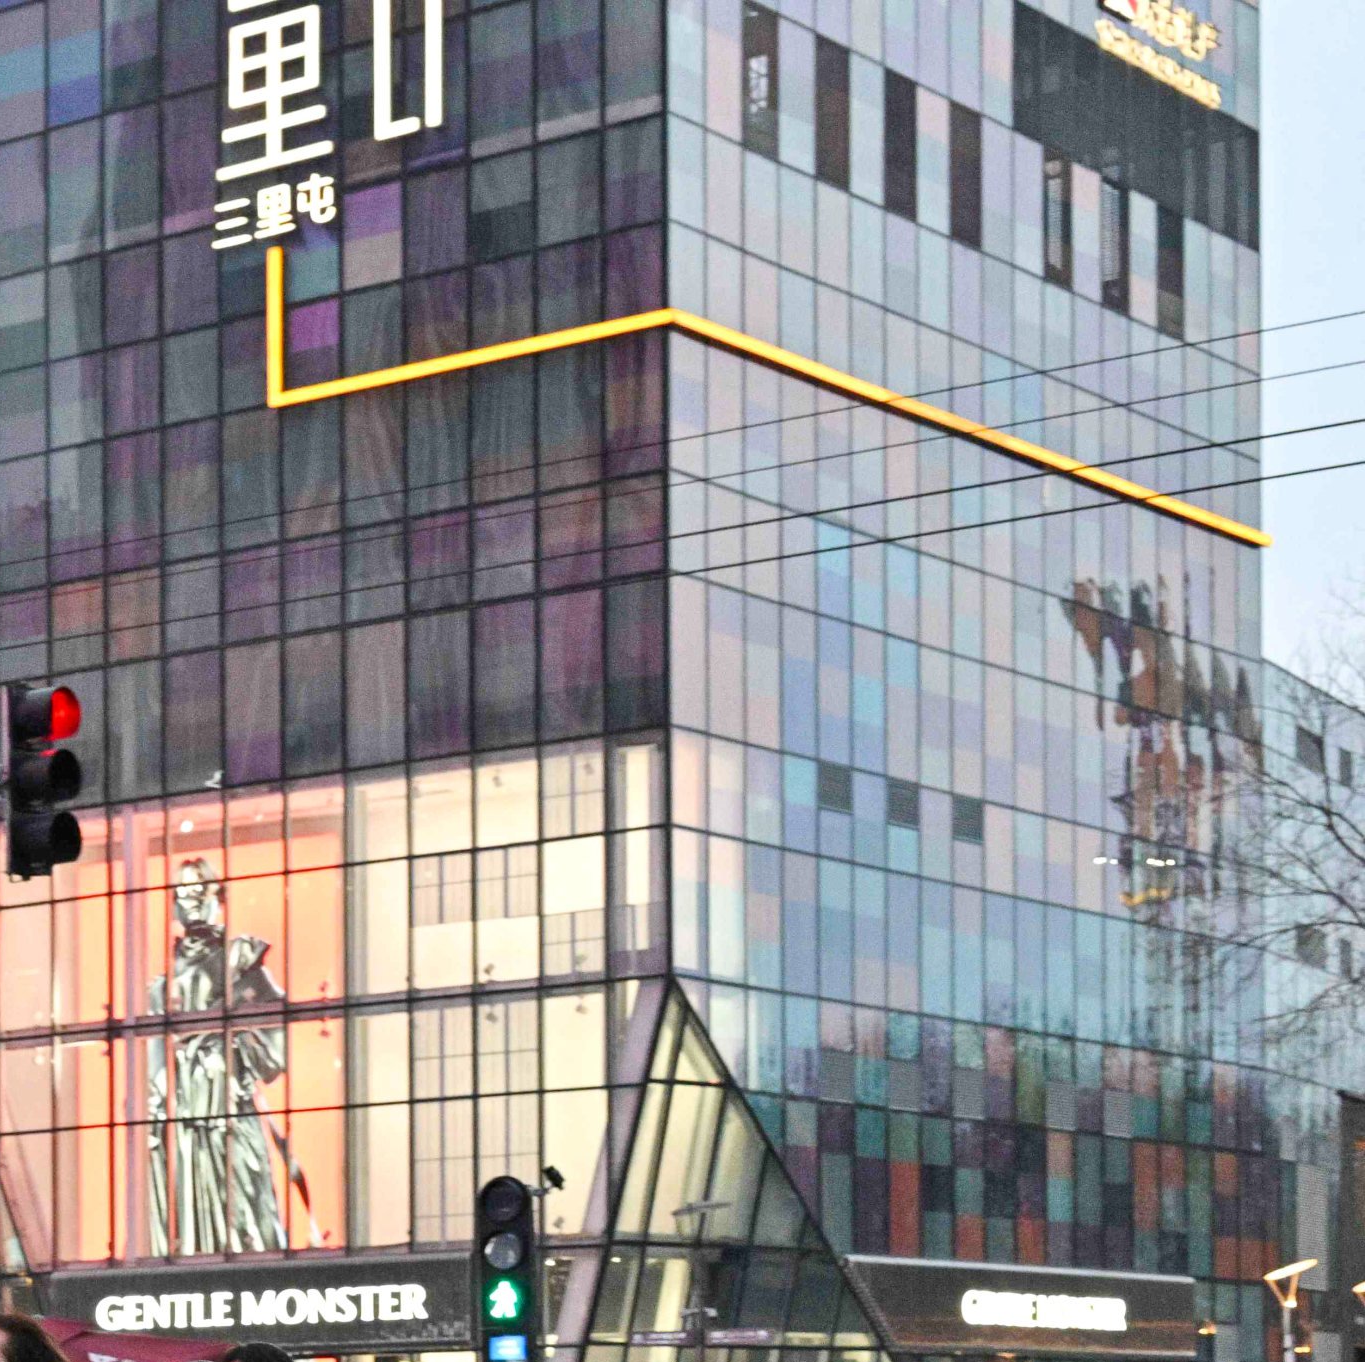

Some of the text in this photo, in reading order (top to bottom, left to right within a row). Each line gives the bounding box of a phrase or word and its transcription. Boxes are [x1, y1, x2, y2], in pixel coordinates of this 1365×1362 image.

[211, 172, 337, 250] 三里屯
[95, 1283, 430, 1331] GENTLE MONSTER
